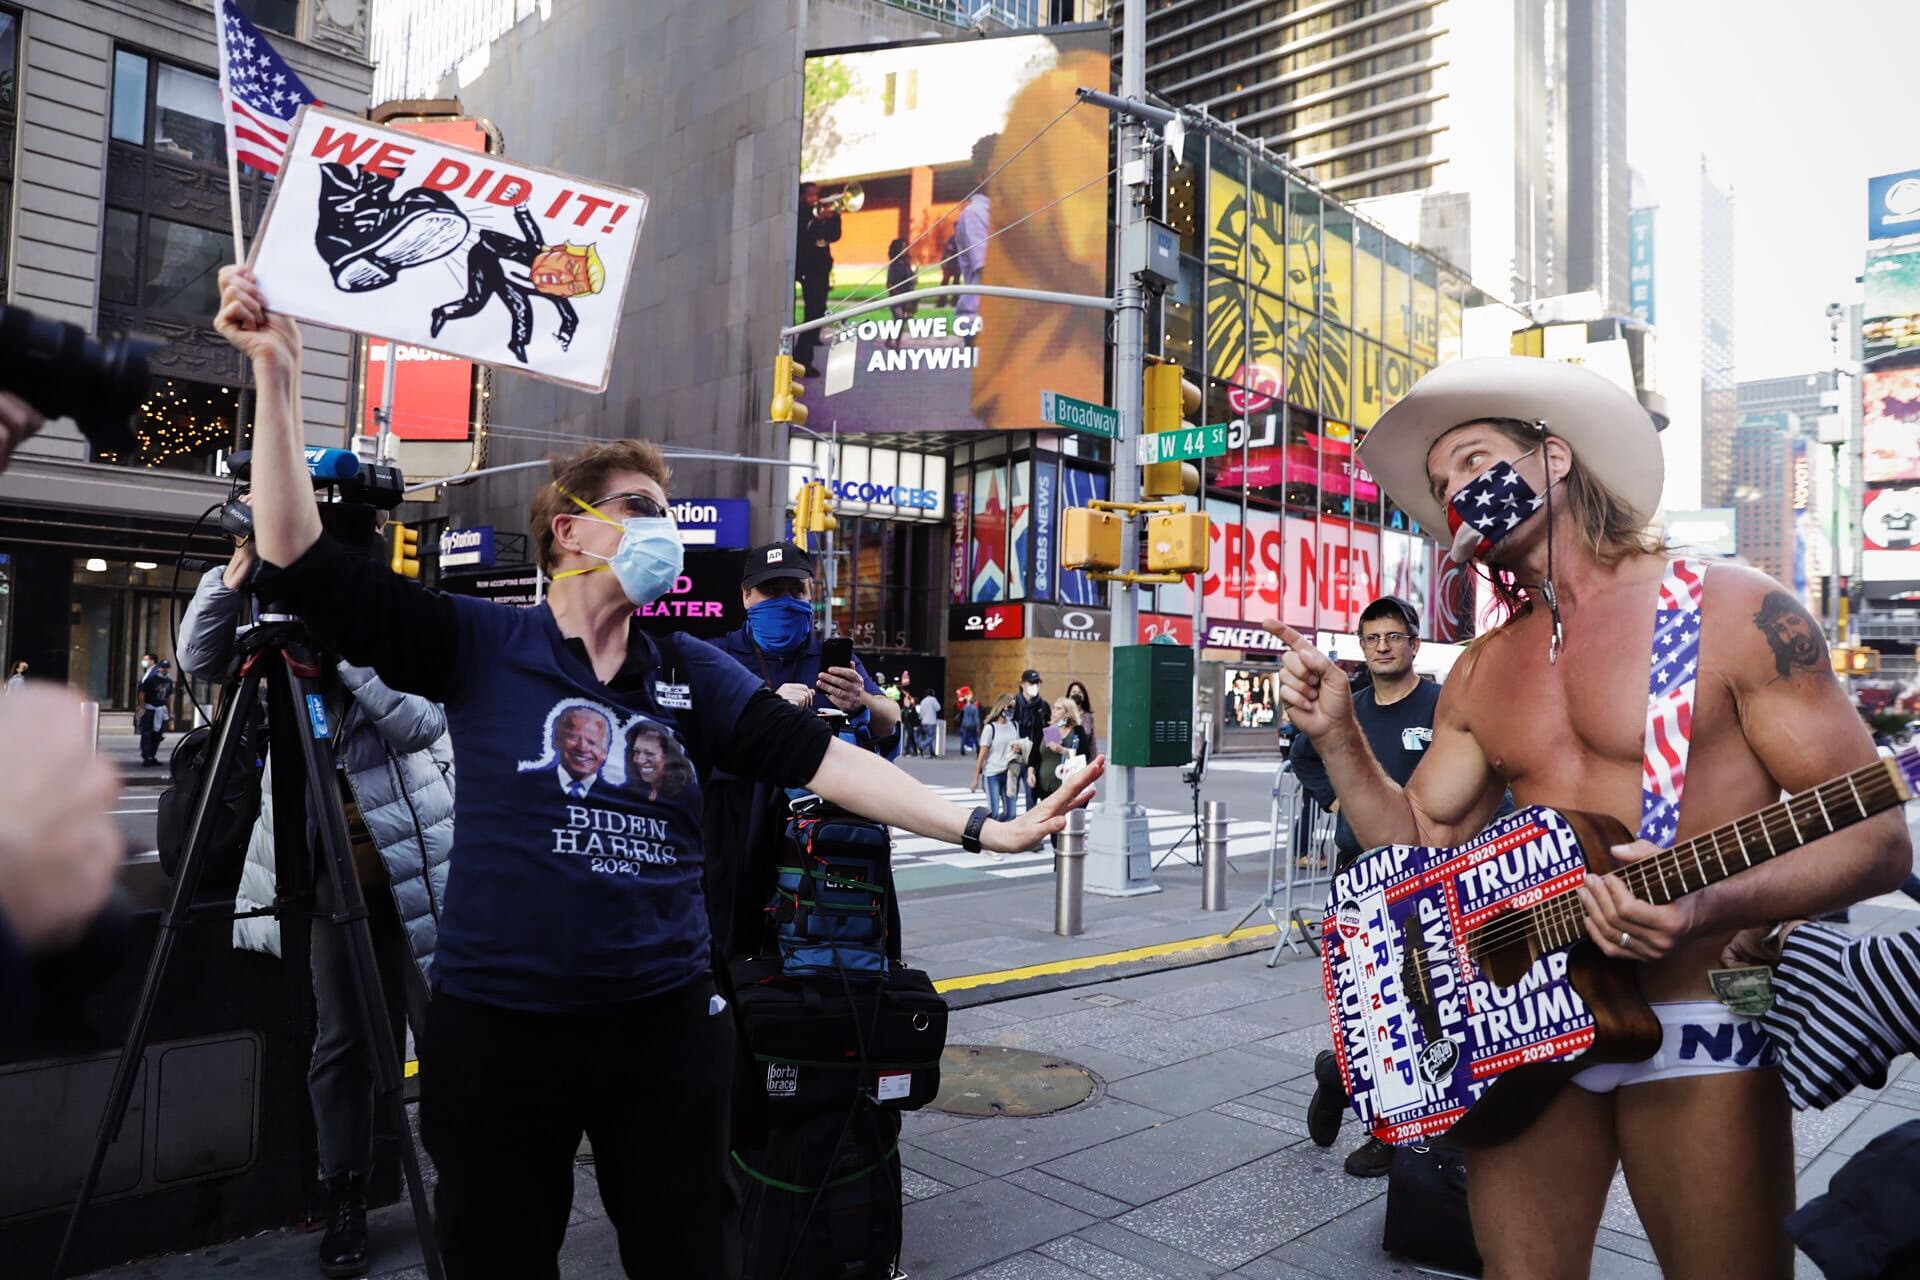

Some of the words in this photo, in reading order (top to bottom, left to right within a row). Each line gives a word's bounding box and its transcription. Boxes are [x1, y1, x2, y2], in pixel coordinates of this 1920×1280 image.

[311, 126, 415, 179] WE
[421, 157, 533, 207] DID
[544, 189, 630, 234] IT!
[908, 317, 946, 338] WE
[952, 315, 983, 336] CA
[1058, 400, 1117, 438] Broadway
[1161, 436, 1176, 458] W
[1184, 432, 1204, 455] 44
[1212, 429, 1223, 444] St
[231, 508, 249, 524] SONY
[1038, 476, 1050, 533] NEWS
[768, 551, 782, 561] AP
[1036, 535, 1048, 574] CBS
[1054, 629, 1101, 641] OAKLEY
[566, 804, 669, 841] BIDEN
[552, 828, 677, 865] HARRIS
[1424, 853, 1447, 870] KEEP
[1452, 829, 1499, 857] AMERICA
[1459, 829, 1577, 900] TRUMP
[1467, 844, 1496, 866] 2020
[591, 857, 641, 876] 2020
[1386, 867, 1416, 887] GREAT
[1463, 896, 1489, 914] KEEP
[1494, 872, 1546, 901] AMERICA
[1550, 856, 1583, 876] GREA
[1437, 889, 1452, 932] GREAT
[1511, 887, 1544, 909] 2020
[1418, 897, 1466, 1044] TRUMP
[1458, 944, 1475, 983] 2020
[1328, 998, 1341, 1034] 2020
[1333, 942, 1372, 1081] TRUMP
[1360, 980, 1373, 1022] AMERICA
[1360, 931, 1395, 1074] PENCE
[1368, 908, 1414, 1086] TRUMP
[1333, 978, 1347, 1037] AMERICA
[1345, 1044, 1357, 1088] GREAT
[1472, 1044, 1498, 1060] KEEP
[1504, 1027, 1557, 1050] AMERICA
[1562, 1013, 1594, 1032] GREA
[1679, 1022, 1777, 1067] NY
[1521, 1042, 1555, 1064] 2020
[768, 1077, 795, 1091] brace
[1427, 1098, 1460, 1114] GREAT
[1396, 1122, 1422, 1139] 2020
